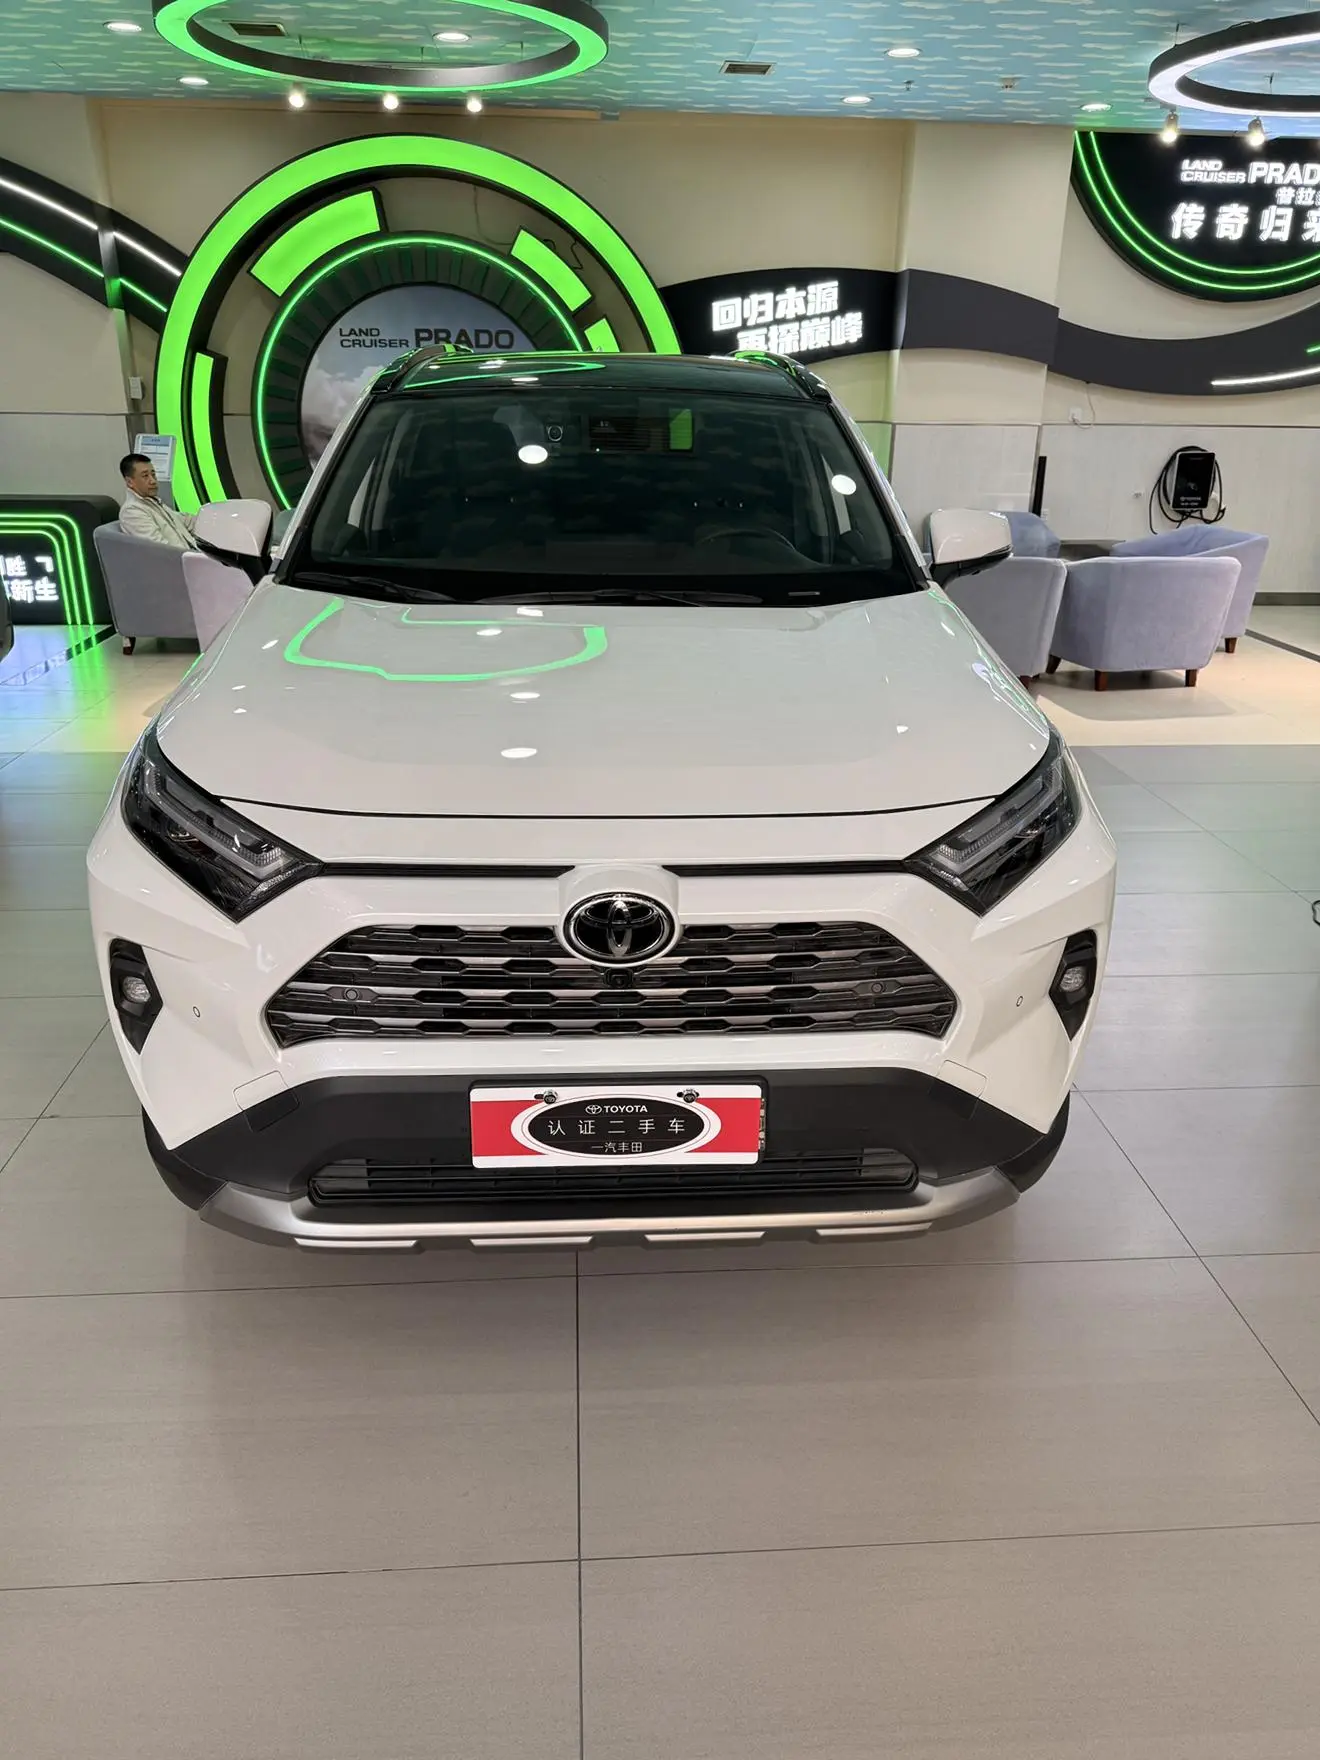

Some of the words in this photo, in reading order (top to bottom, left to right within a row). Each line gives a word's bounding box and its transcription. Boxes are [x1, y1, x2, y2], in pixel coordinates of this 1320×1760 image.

[1181, 159, 1222, 171] LAND
[1180, 171, 1246, 184] CRUISER
[1275, 186, 1320, 206] 普拉
[712, 280, 839, 332] 回归本源
[339, 328, 380, 337] LAND
[414, 328, 515, 350] PRADO
[737, 312, 863, 354] 再探巅峰
[340, 338, 409, 348] CRUISER
[603, 1105, 648, 1113] TOYOTA
[548, 1117, 686, 1136] 认证二手车
[591, 1142, 643, 1153] 一汽丰田
